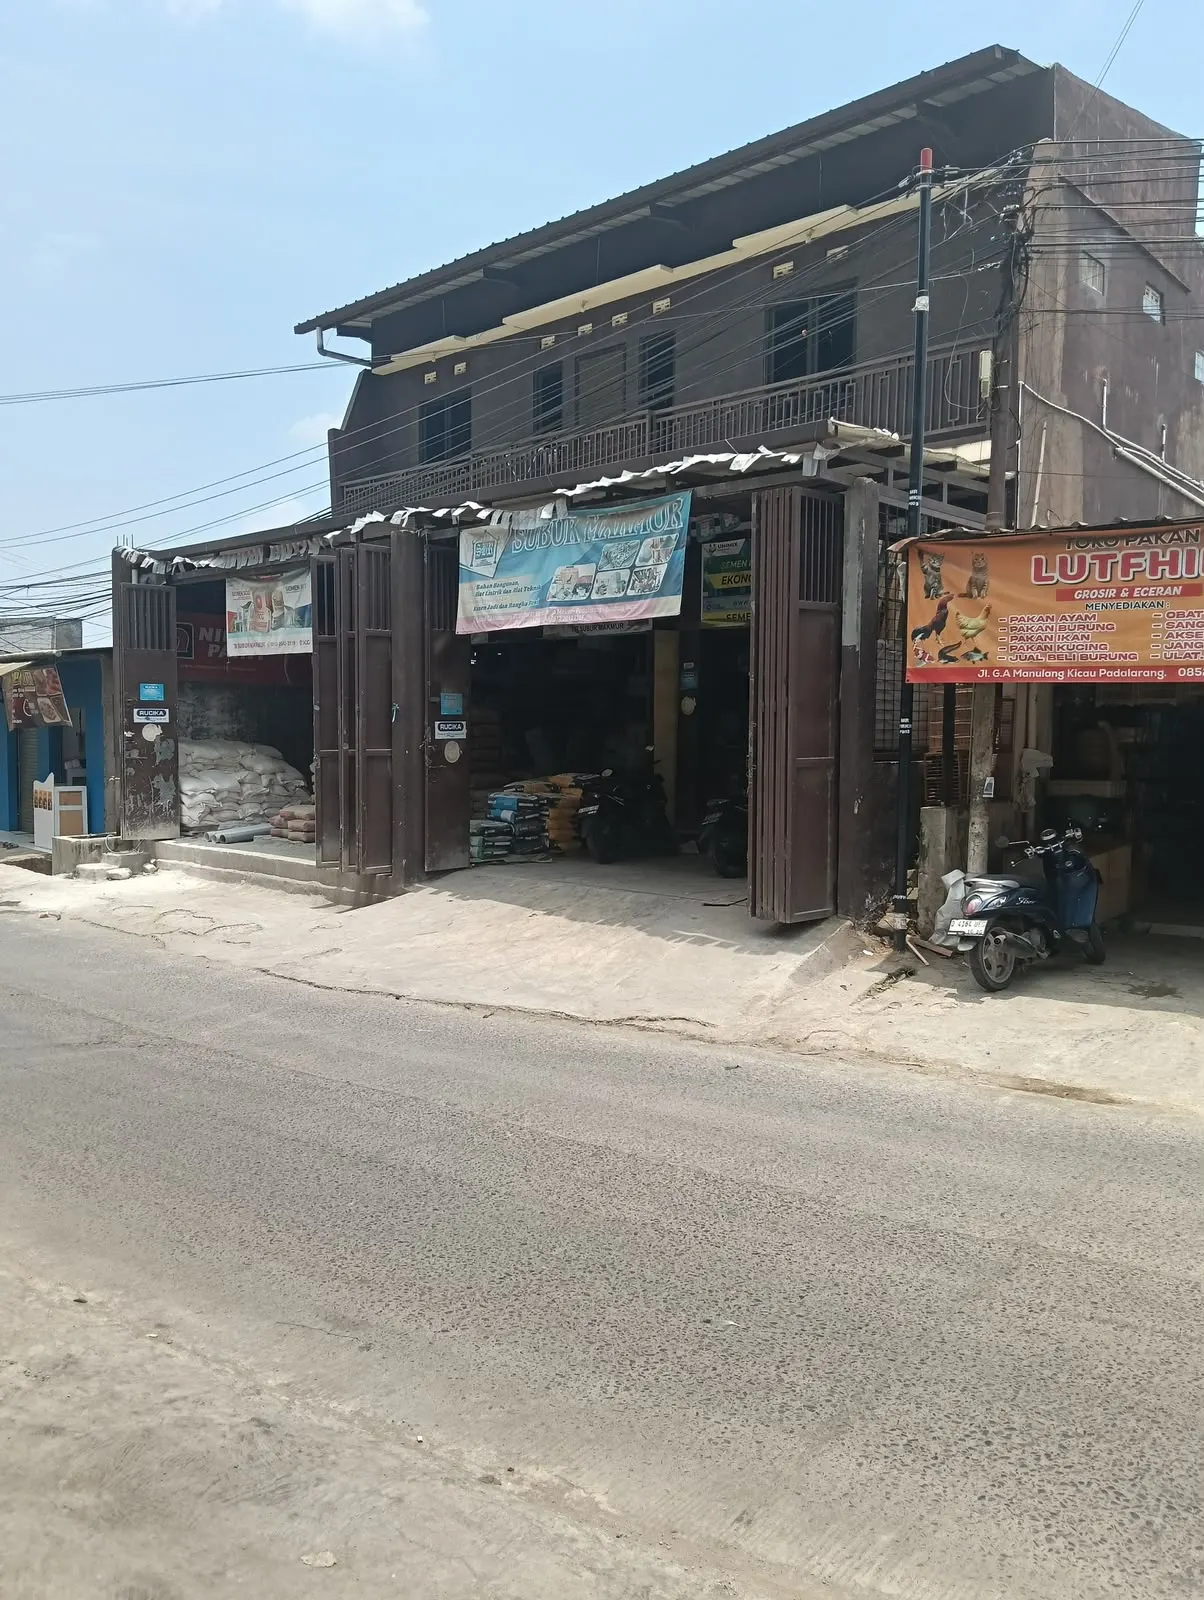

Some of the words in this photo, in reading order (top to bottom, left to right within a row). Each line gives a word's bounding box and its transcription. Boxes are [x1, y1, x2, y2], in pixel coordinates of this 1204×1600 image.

[1064, 536, 1120, 550] TOKO
[1124, 528, 1200, 547] PAKAN
[1031, 547, 1204, 585] LUTFHI
[1074, 590, 1116, 600] GROSIR
[1120, 589, 1129, 598] &
[1133, 586, 1183, 597] ECERAN
[1009, 615, 1055, 624] PAKAN
[1058, 613, 1097, 623] AYAM
[1165, 610, 1204, 619] OBAT
[1009, 625, 1055, 634] PAKAN
[1056, 623, 1116, 633] BURUNG
[1009, 634, 1054, 643] PAKAN
[1056, 633, 1091, 642] IKAN
[1164, 631, 1204, 640] AKSE
[1009, 644, 1054, 653] PAKAN
[1056, 643, 1109, 652] KUCING
[1164, 641, 1204, 650] JANG
[1009, 653, 1044, 662] JUAL
[1047, 653, 1076, 661] BELI
[1079, 652, 1138, 661] BURUNG
[977, 669, 990, 678] Jl.
[993, 669, 1011, 678] G.A
[1013, 669, 1065, 680] Manulang
[1067, 669, 1096, 678] Kicau
[1099, 668, 1167, 680] Padalarang.
[1177, 667, 1204, 677] 085
